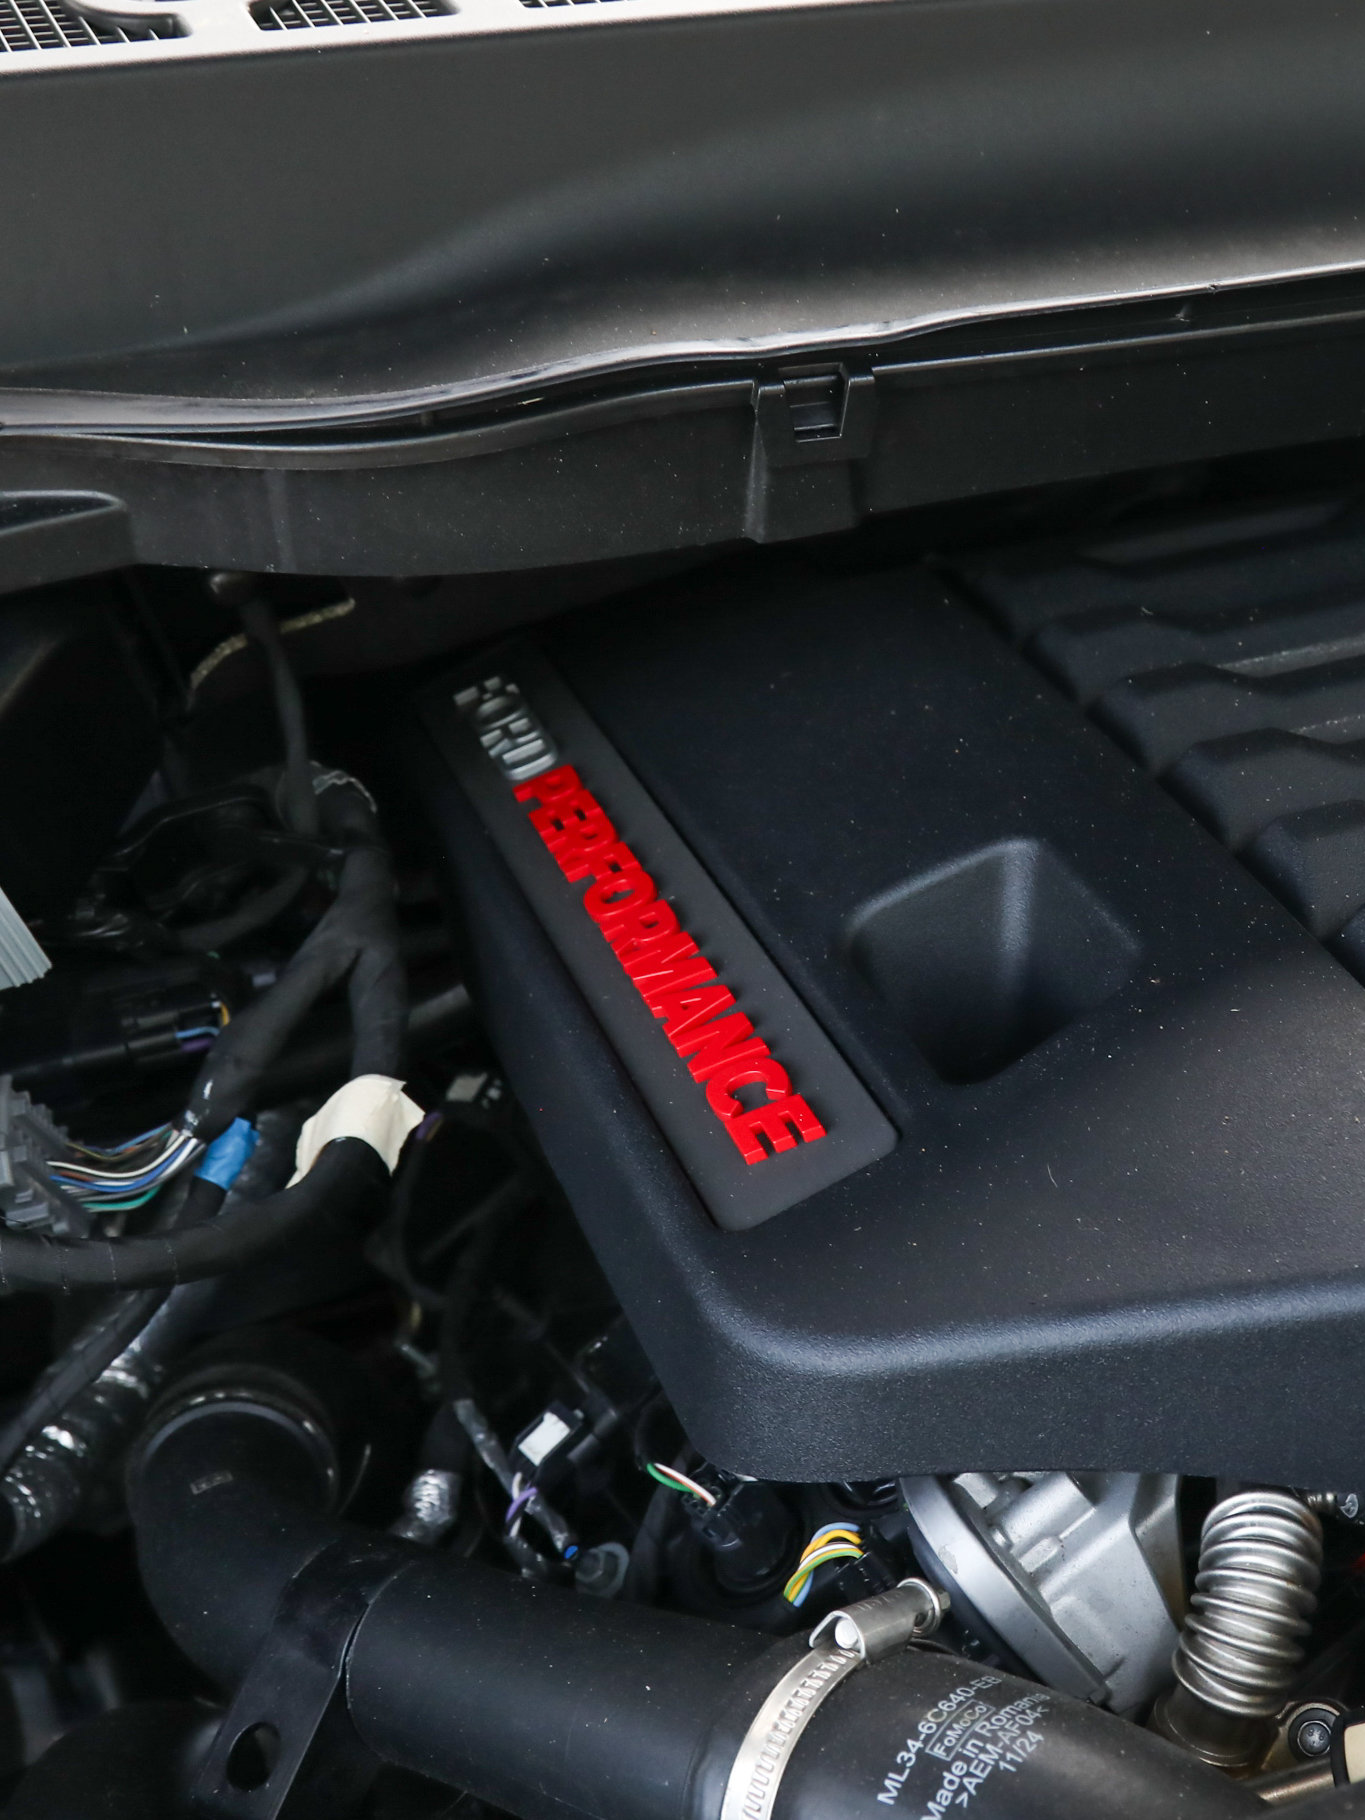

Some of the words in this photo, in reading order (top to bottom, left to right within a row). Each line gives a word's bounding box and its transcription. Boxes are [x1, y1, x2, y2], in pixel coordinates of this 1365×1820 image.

[453, 675, 558, 781] FORD
[512, 764, 827, 1166] PERFORMANCE
[877, 1675, 1002, 1805] ML34-6C640-EB
[933, 1702, 988, 1757] FoMoCo
[998, 1730, 1044, 1772] 11/24
[920, 1760, 968, 1820] Made
[958, 1738, 985, 1759] in
